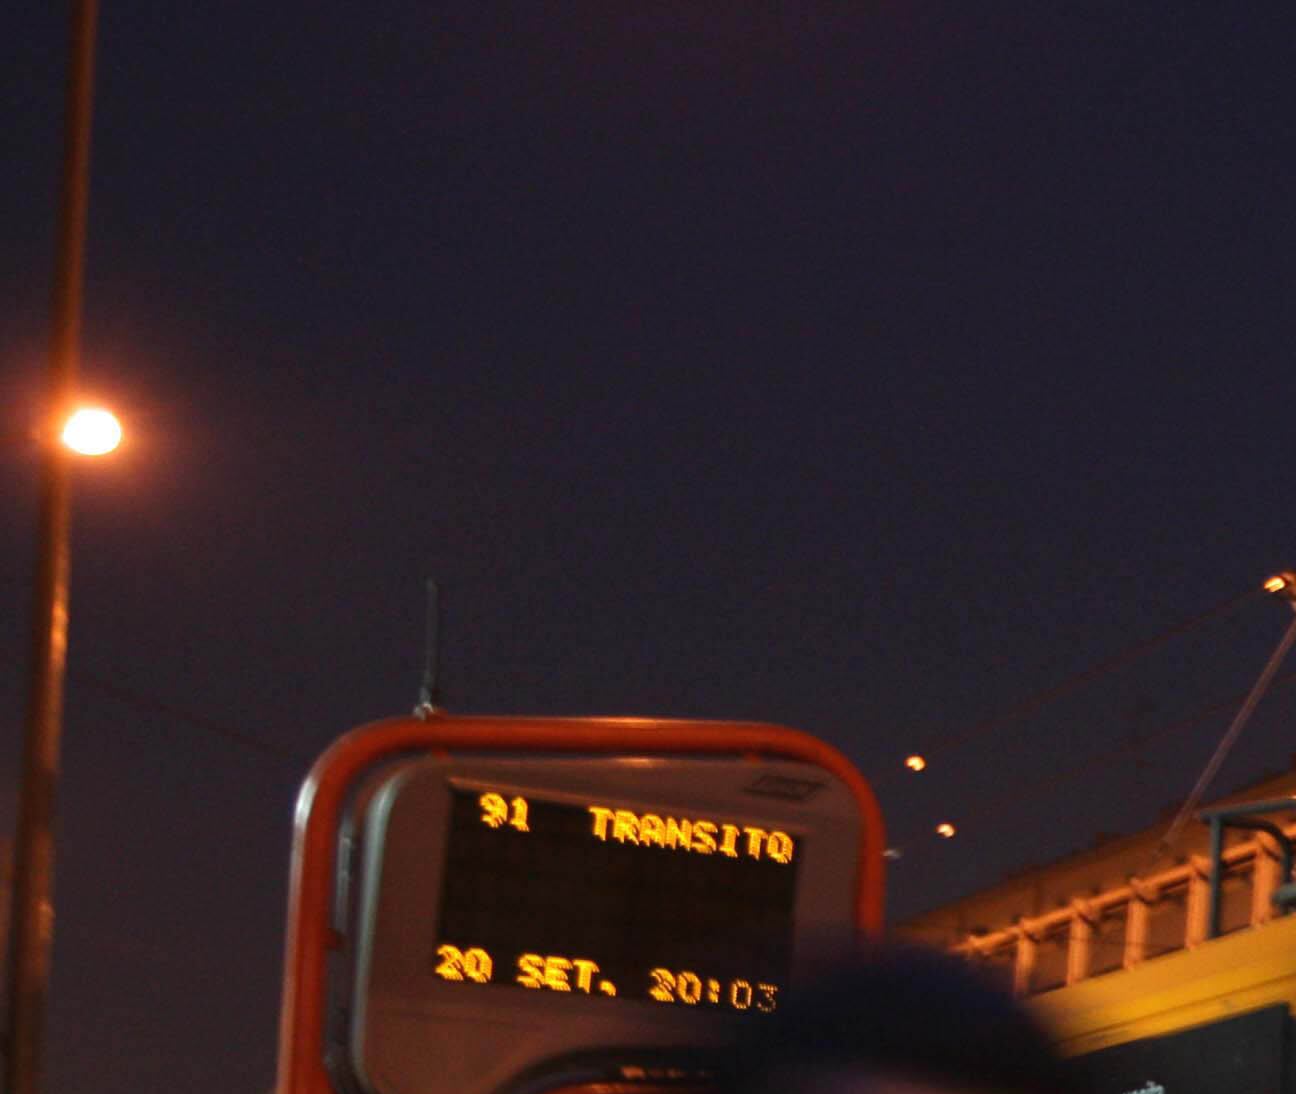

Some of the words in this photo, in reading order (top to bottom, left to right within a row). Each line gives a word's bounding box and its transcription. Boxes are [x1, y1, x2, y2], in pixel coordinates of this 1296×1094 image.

[479, 792, 530, 832] 91
[588, 806, 794, 864] TRANSITO
[434, 944, 493, 983] 20
[515, 953, 617, 997] SET.
[649, 967, 779, 1013] 20:03
